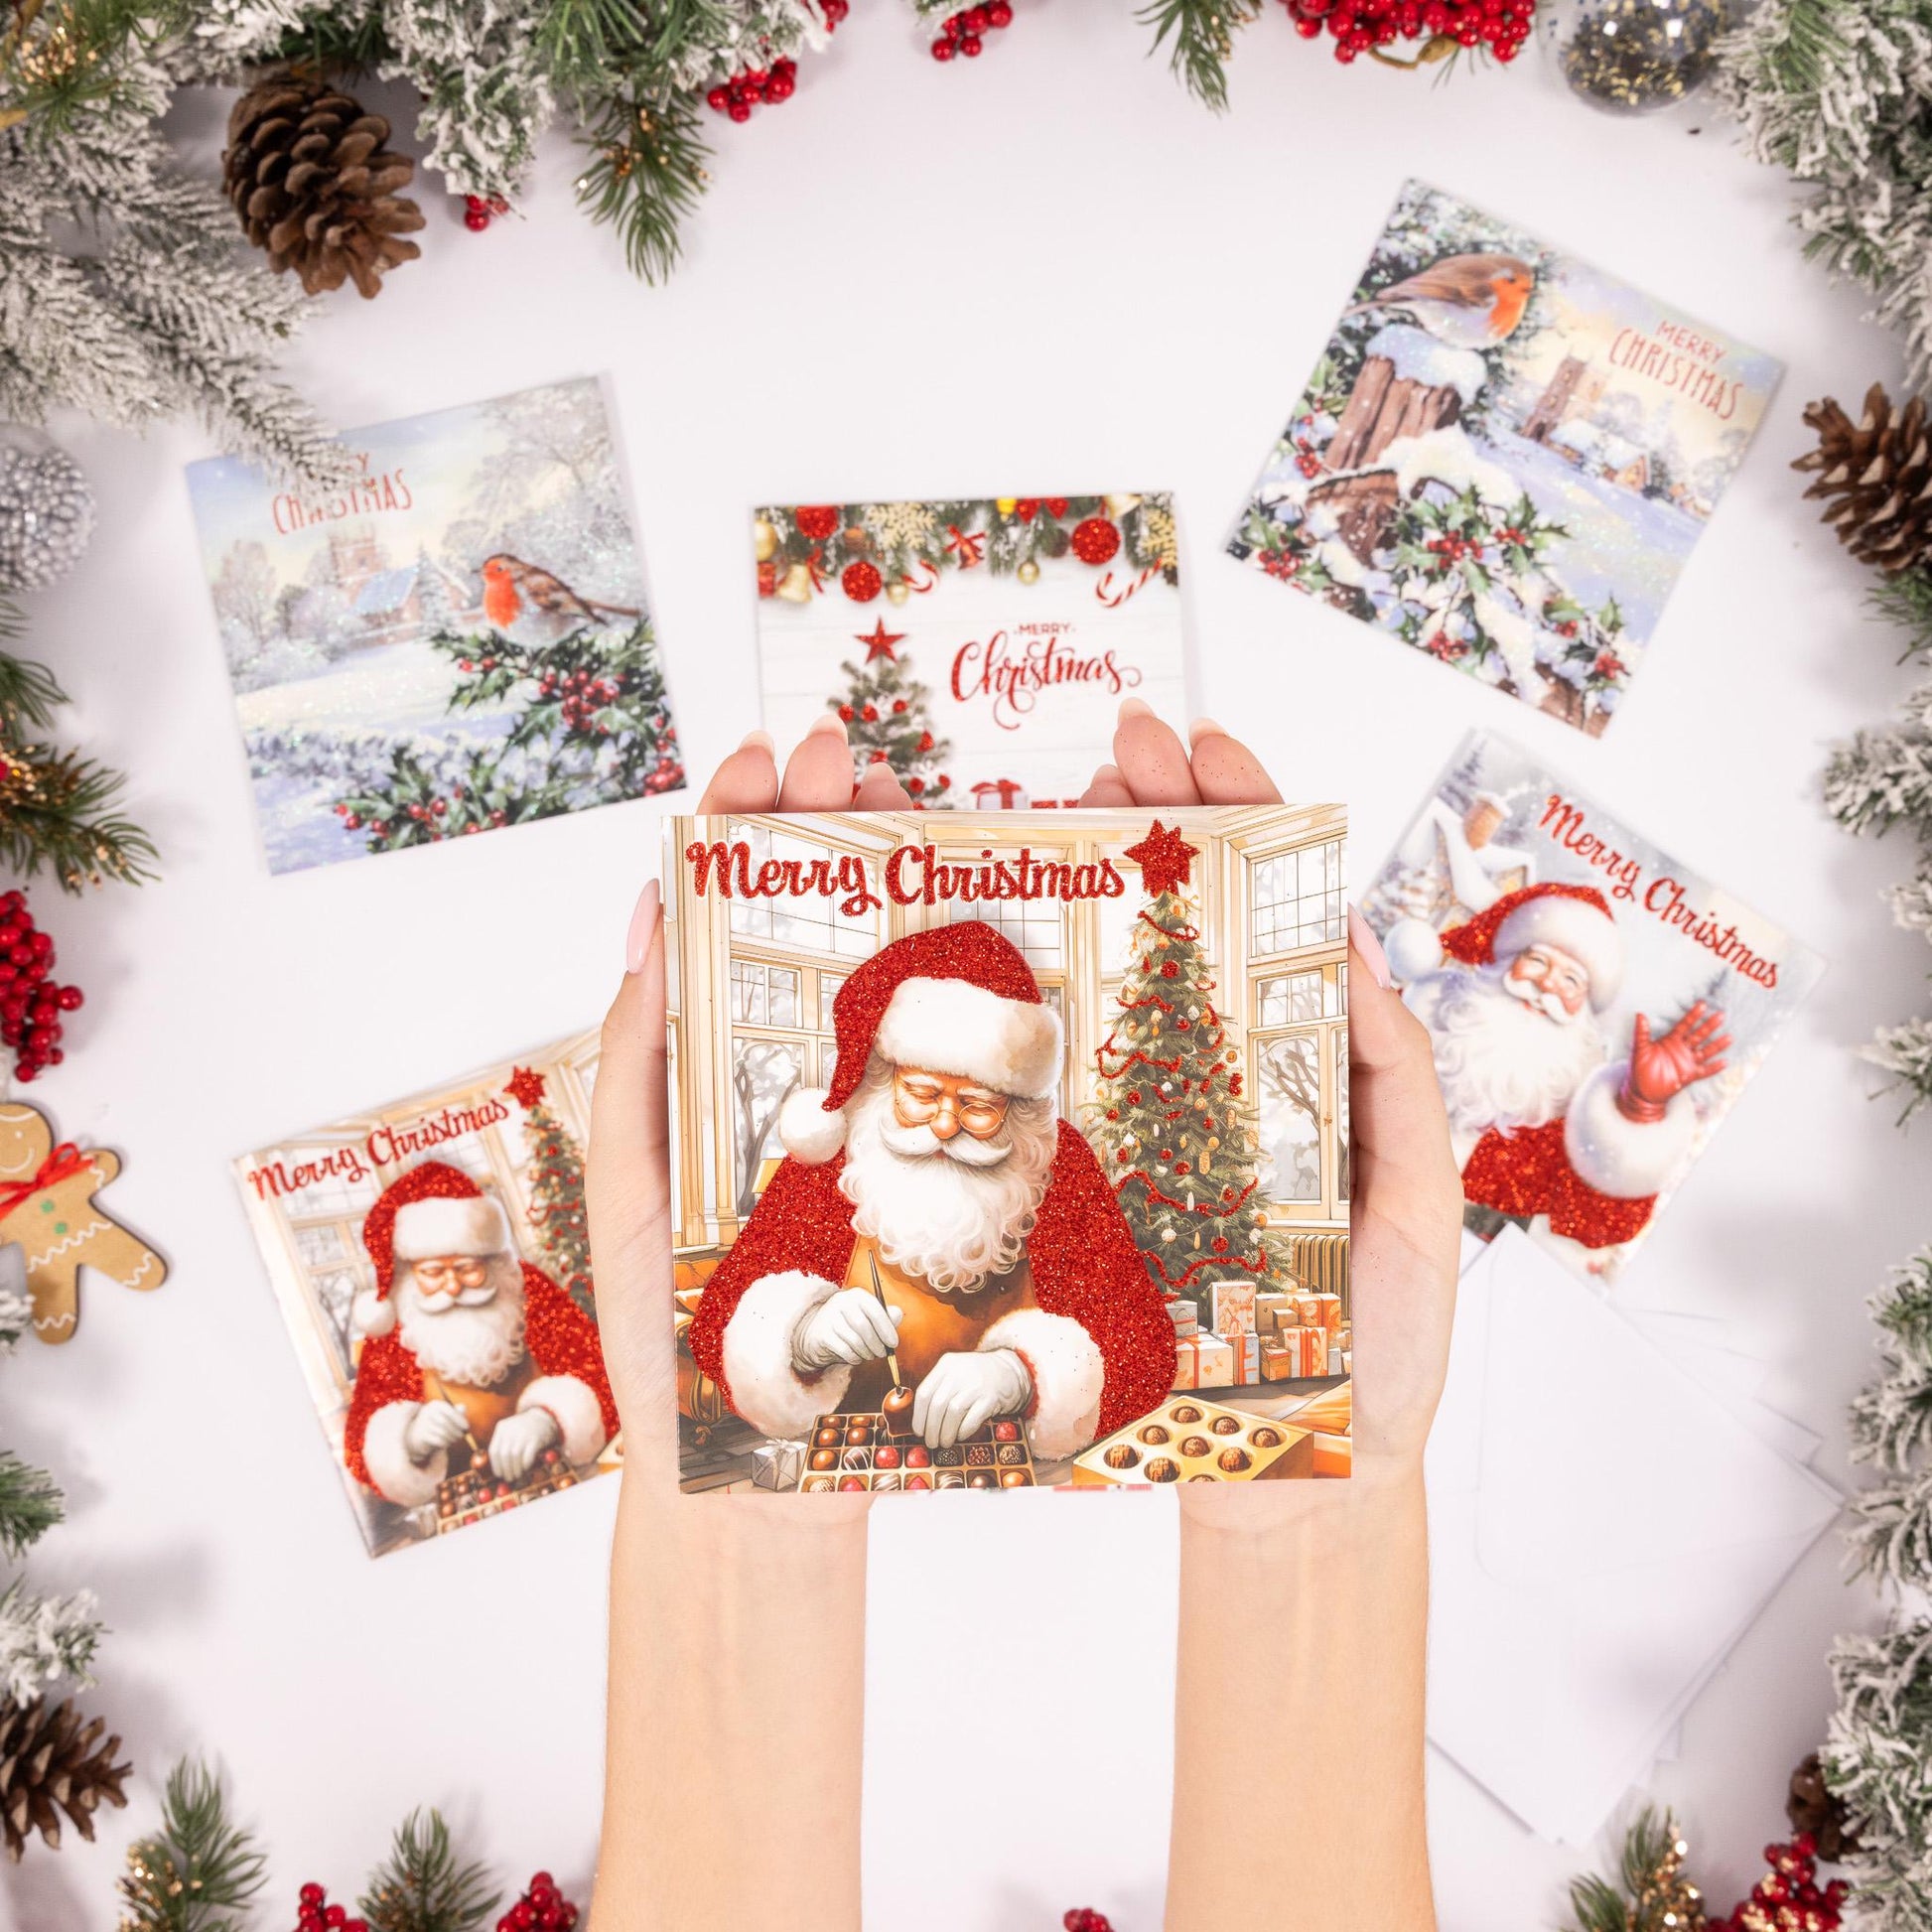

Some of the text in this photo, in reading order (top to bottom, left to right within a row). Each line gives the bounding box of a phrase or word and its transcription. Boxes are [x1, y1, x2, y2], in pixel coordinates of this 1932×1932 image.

[1608, 327, 1744, 421] CHRISTMAS
[1656, 320, 1727, 364] MERRY
[1019, 622, 1071, 635] MERRY
[951, 630, 1142, 731] Christmas
[685, 841, 1125, 916] Merry Christmas
[1539, 793, 1778, 989] Merry Christmas
[248, 1098, 509, 1200] Merry Christmas
